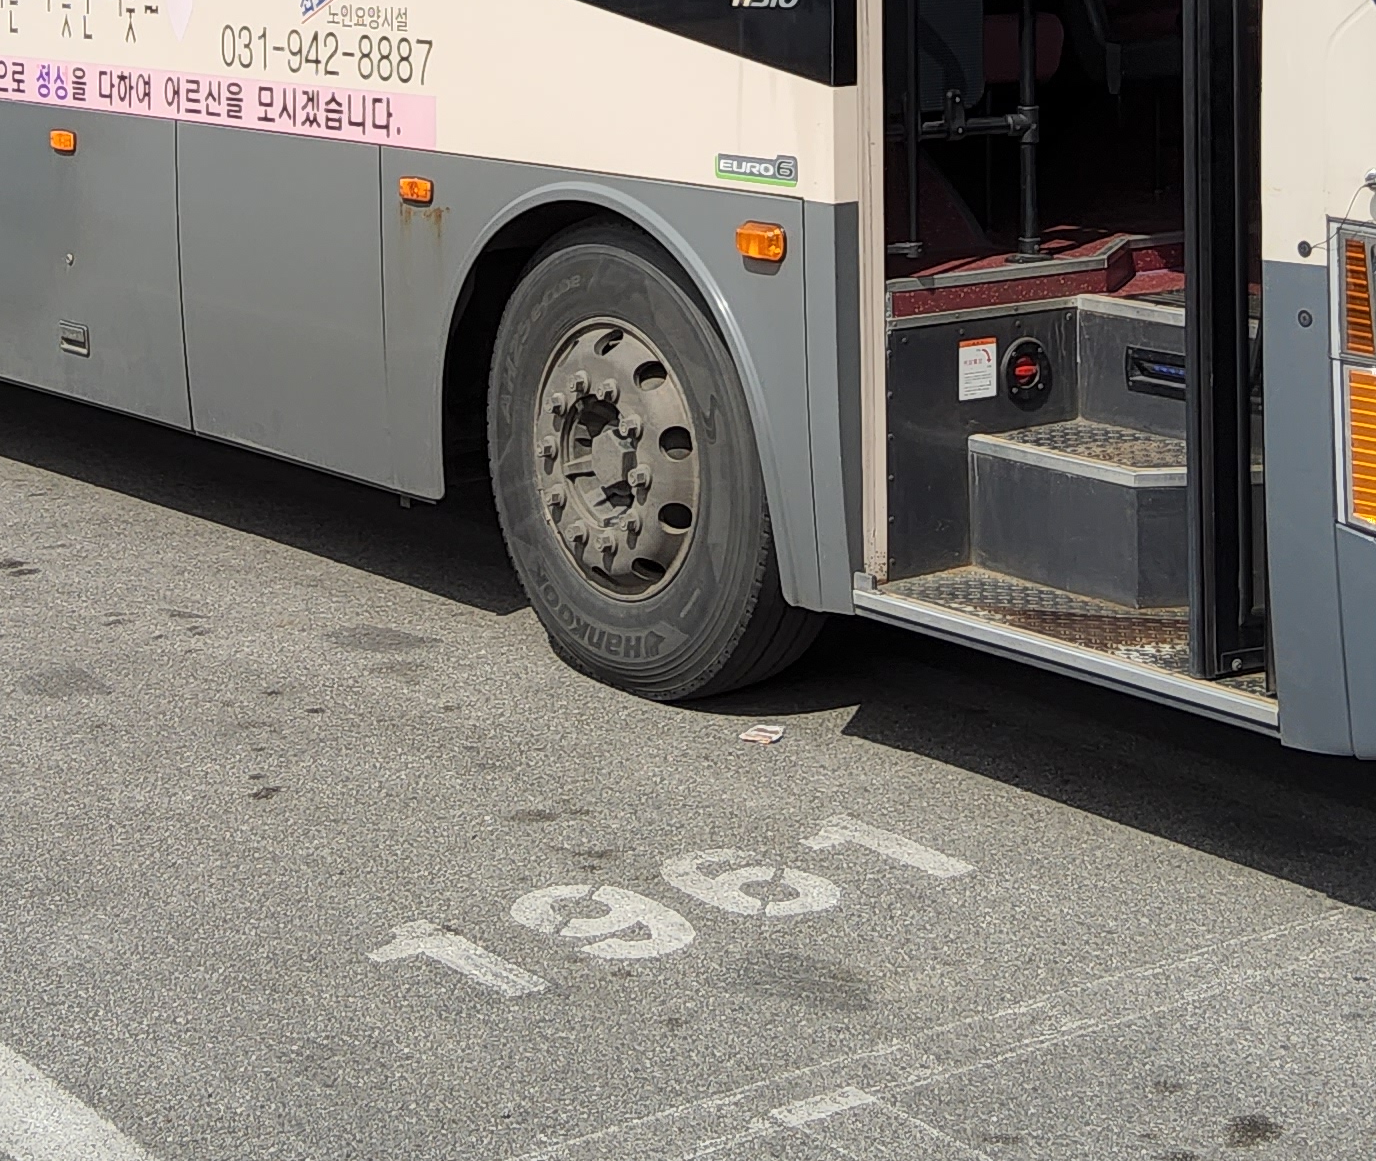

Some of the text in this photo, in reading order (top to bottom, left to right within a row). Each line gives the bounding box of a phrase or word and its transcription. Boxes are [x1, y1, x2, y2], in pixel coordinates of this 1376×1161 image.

[326, 4, 409, 32] 노인요양시설
[221, 23, 433, 86] 031-942-8887
[35, 63, 88, 102] 정성을
[98, 69, 152, 110] 다하여
[164, 75, 244, 120] 어르신을
[257, 86, 402, 138] 모시겠습니다.
[367, 814, 978, 997] 1961
